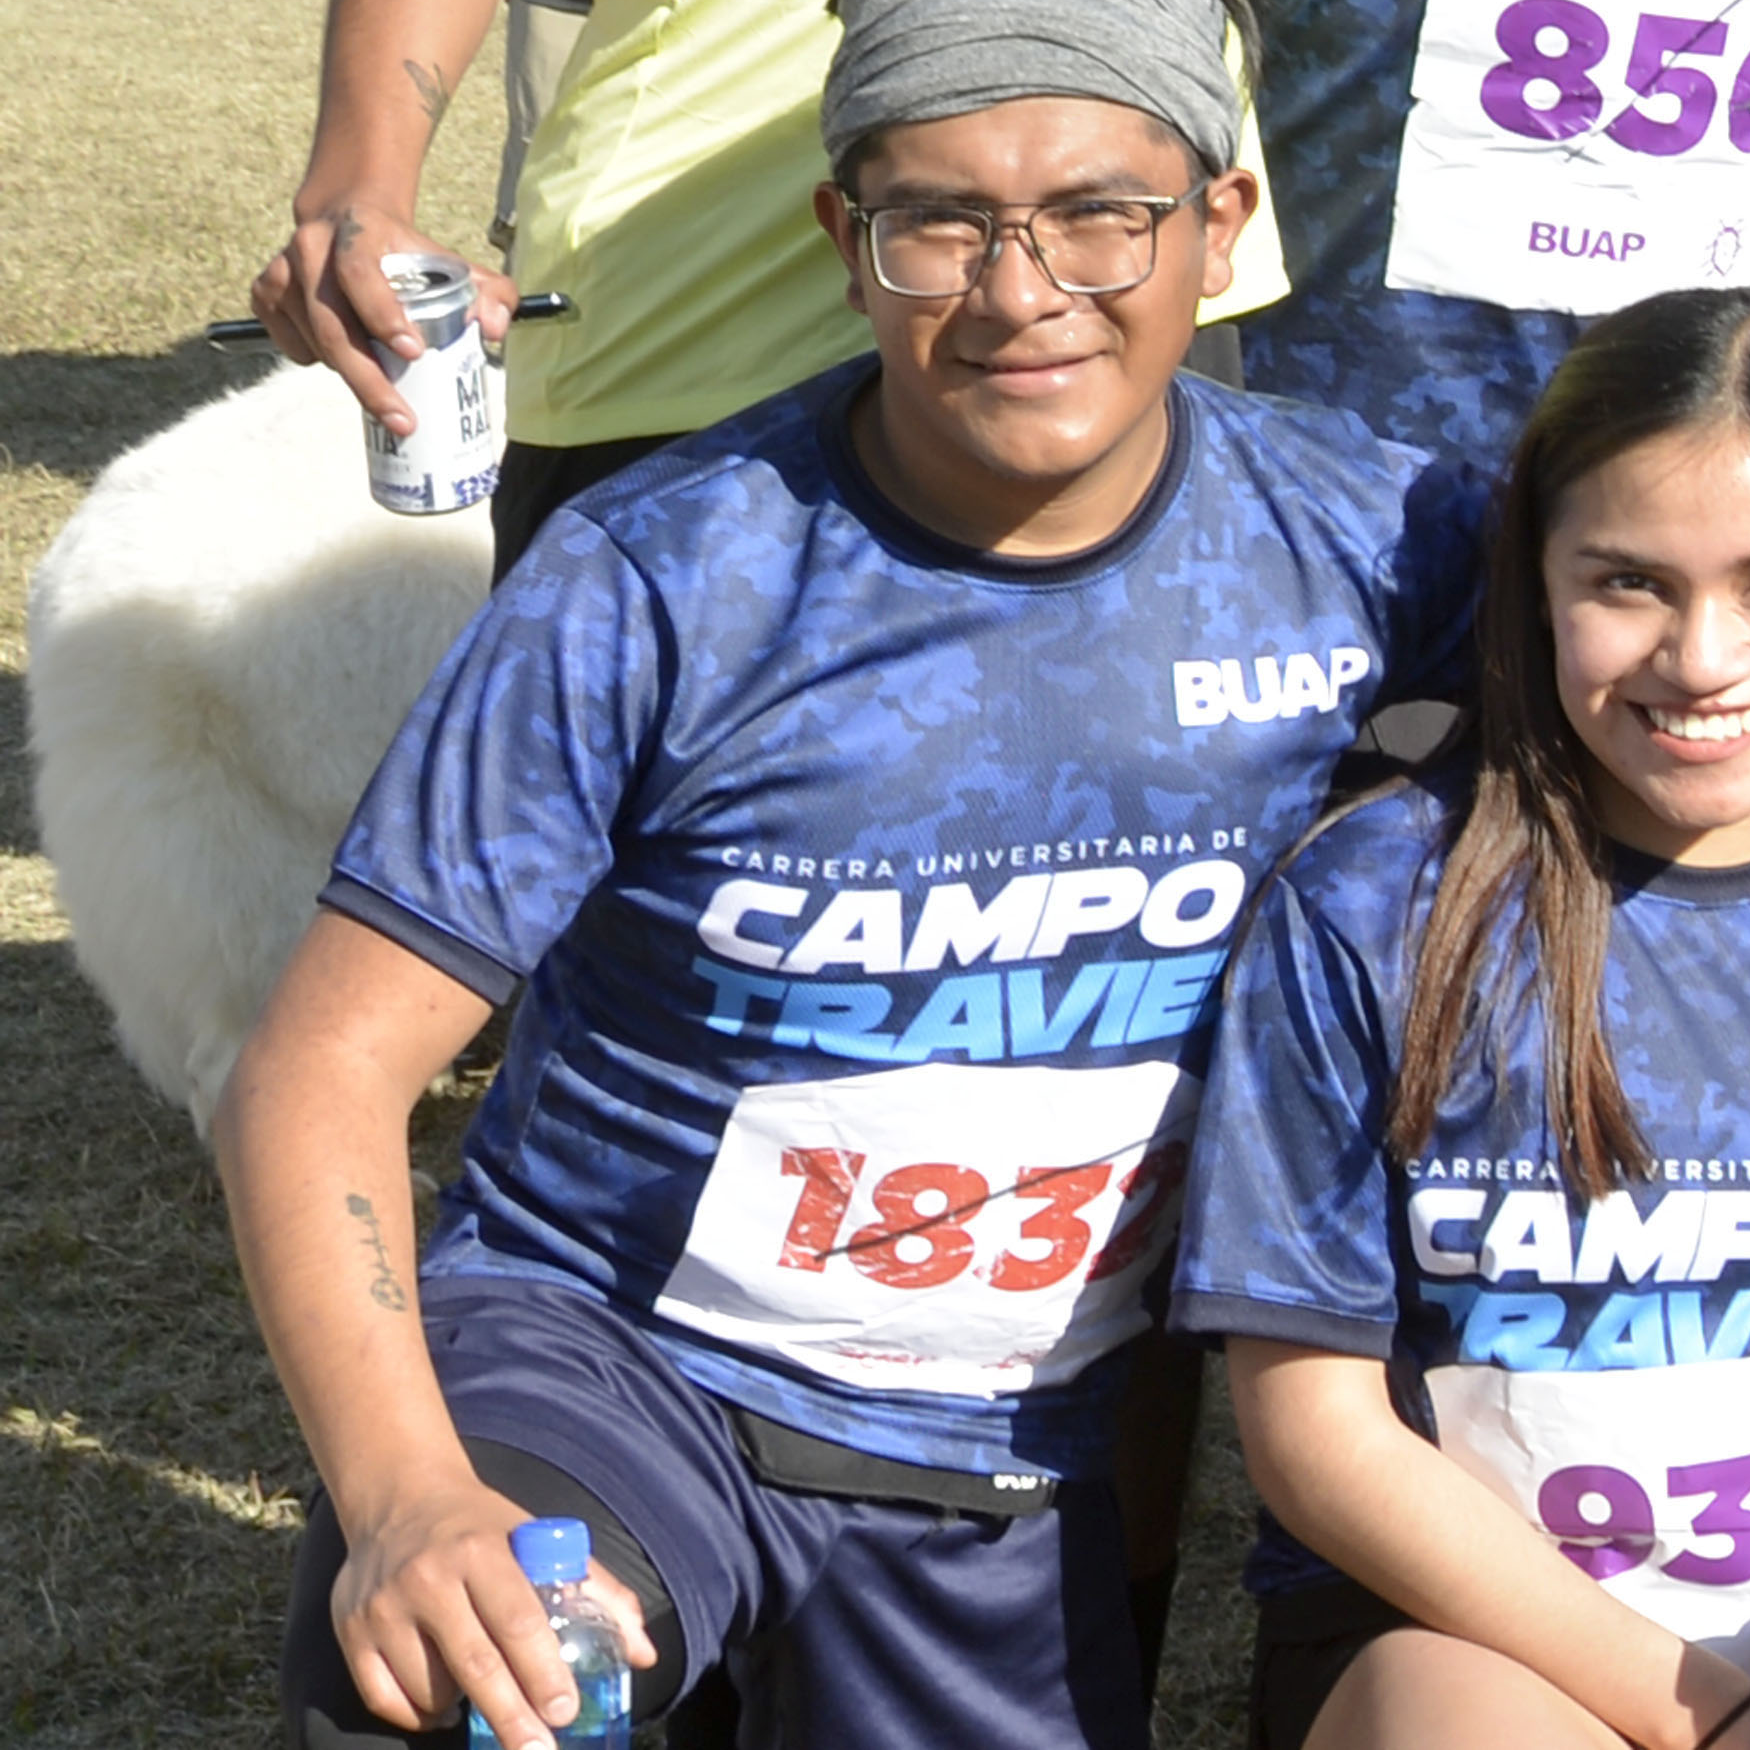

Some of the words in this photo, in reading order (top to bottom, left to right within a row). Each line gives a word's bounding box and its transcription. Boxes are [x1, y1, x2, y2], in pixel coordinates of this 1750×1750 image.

[1527, 220, 1647, 263] BUAP
[1172, 646, 1371, 728] BUAP
[721, 847, 895, 880] CARRERA
[916, 835, 1196, 878] UNIVERSITARIA
[1212, 826, 1248, 850] DE
[697, 859, 1246, 975] CAMPO
[1406, 1157, 1561, 1180] CARRERA
